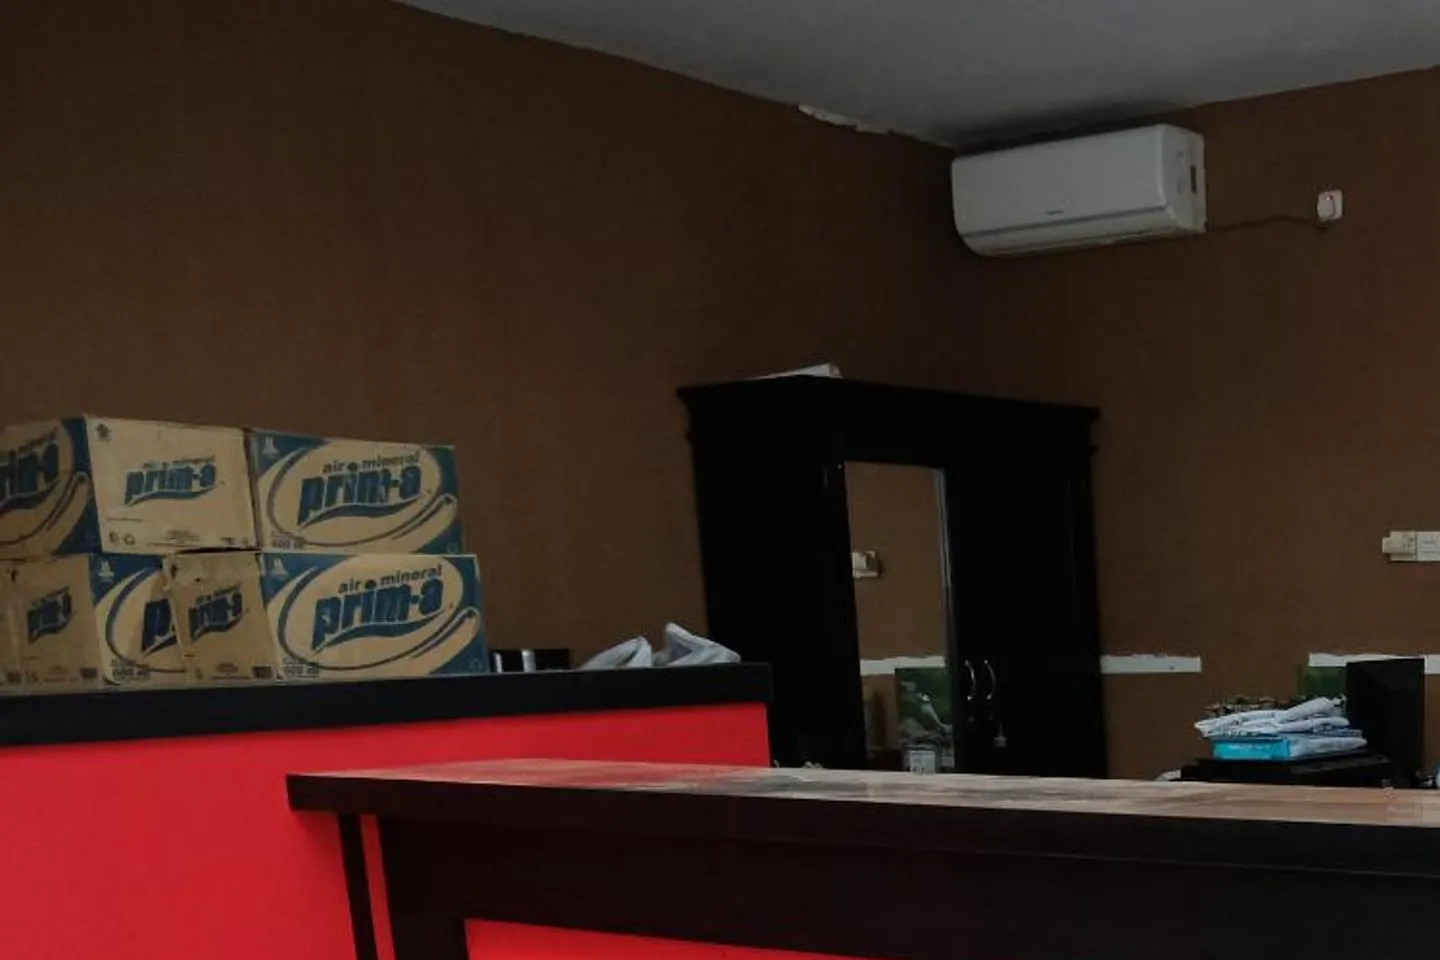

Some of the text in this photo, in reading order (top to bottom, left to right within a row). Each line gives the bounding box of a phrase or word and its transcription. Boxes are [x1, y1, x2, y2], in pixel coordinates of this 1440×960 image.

[322, 452, 420, 474] air mineral
[297, 465, 421, 526] prim-a
[338, 565, 442, 593] air mineral
[312, 578, 444, 652] prim-a
